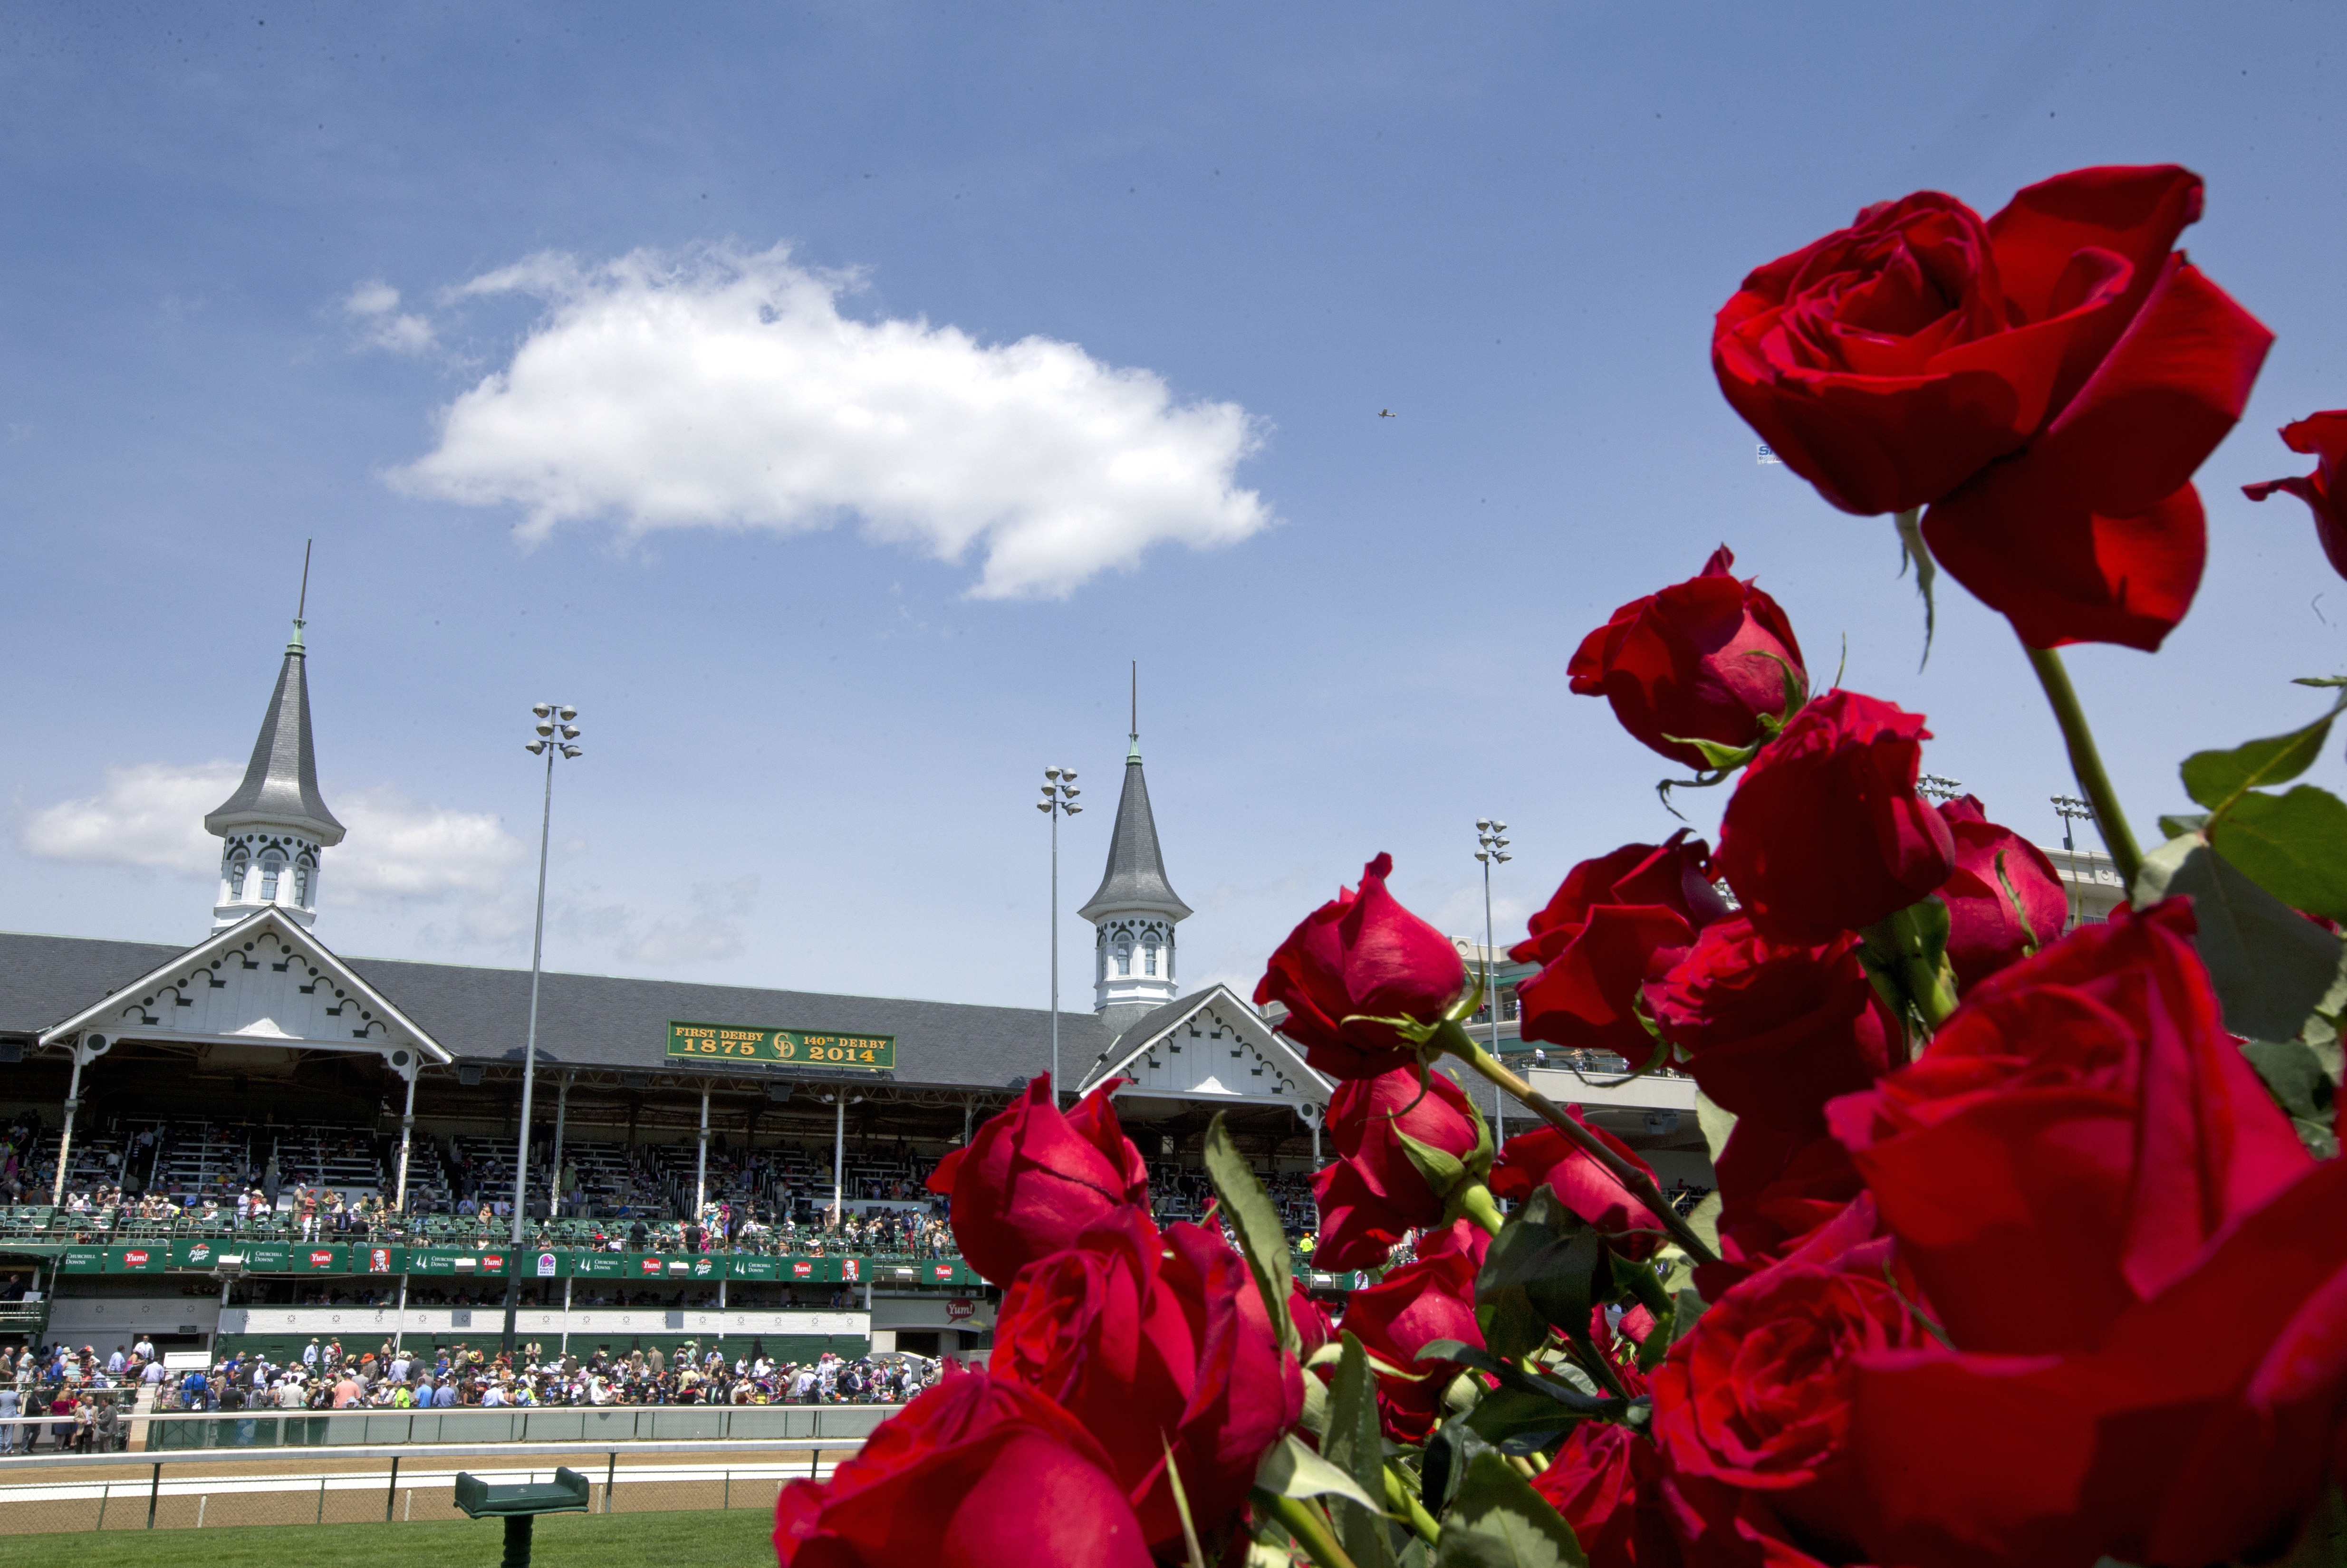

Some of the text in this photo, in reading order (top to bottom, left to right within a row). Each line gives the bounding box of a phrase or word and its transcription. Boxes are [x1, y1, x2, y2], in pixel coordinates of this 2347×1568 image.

[675, 1027, 764, 1042] FIRST DERBY
[684, 1039, 755, 1055] 1875
[838, 1038, 886, 1050] DERBY
[809, 1046, 875, 1063] 2014
[126, 1253, 148, 1262] Yum!
[189, 1249, 210, 1258] Pizza
[192, 1254, 207, 1262] Hut
[311, 1253, 331, 1262] Yum!
[483, 1258, 502, 1266] Yum!
[695, 1263, 712, 1272] Pizza
[948, 1304, 972, 1315] Yum!
